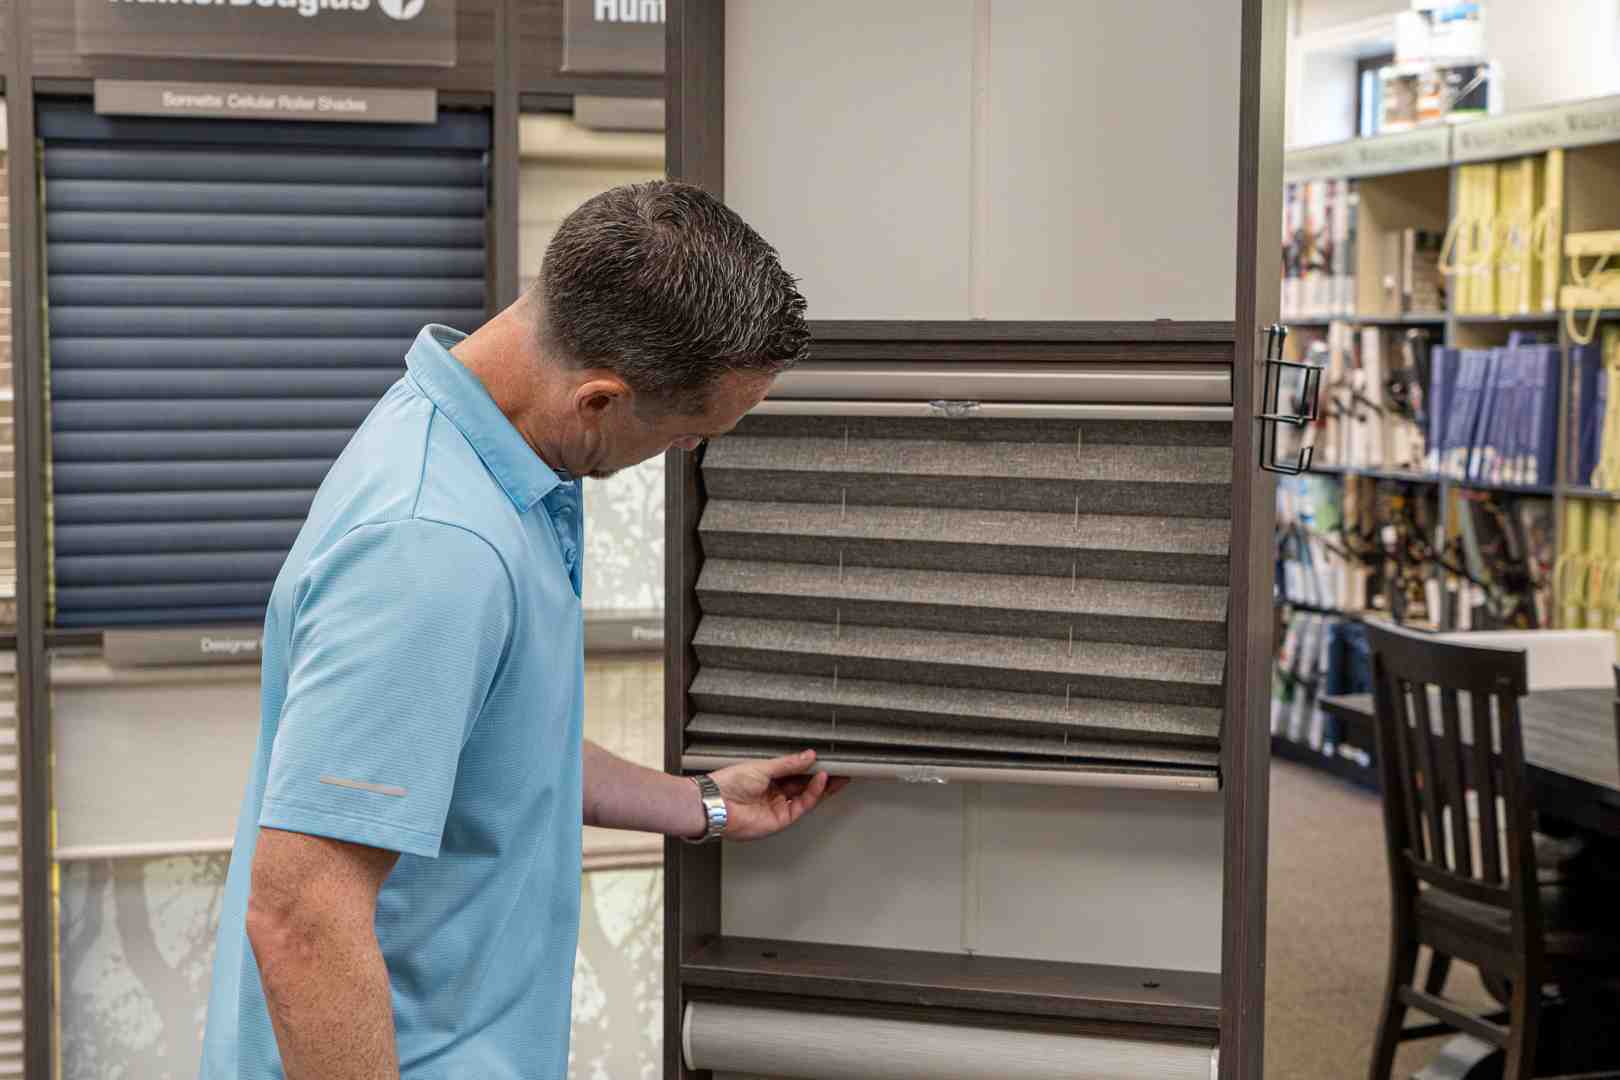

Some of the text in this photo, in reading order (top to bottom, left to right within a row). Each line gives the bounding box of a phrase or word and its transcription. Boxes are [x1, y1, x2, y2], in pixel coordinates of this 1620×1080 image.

[278, 95, 315, 110] Roller
[319, 96, 367, 111] Shades
[201, 637, 258, 654] Designer
